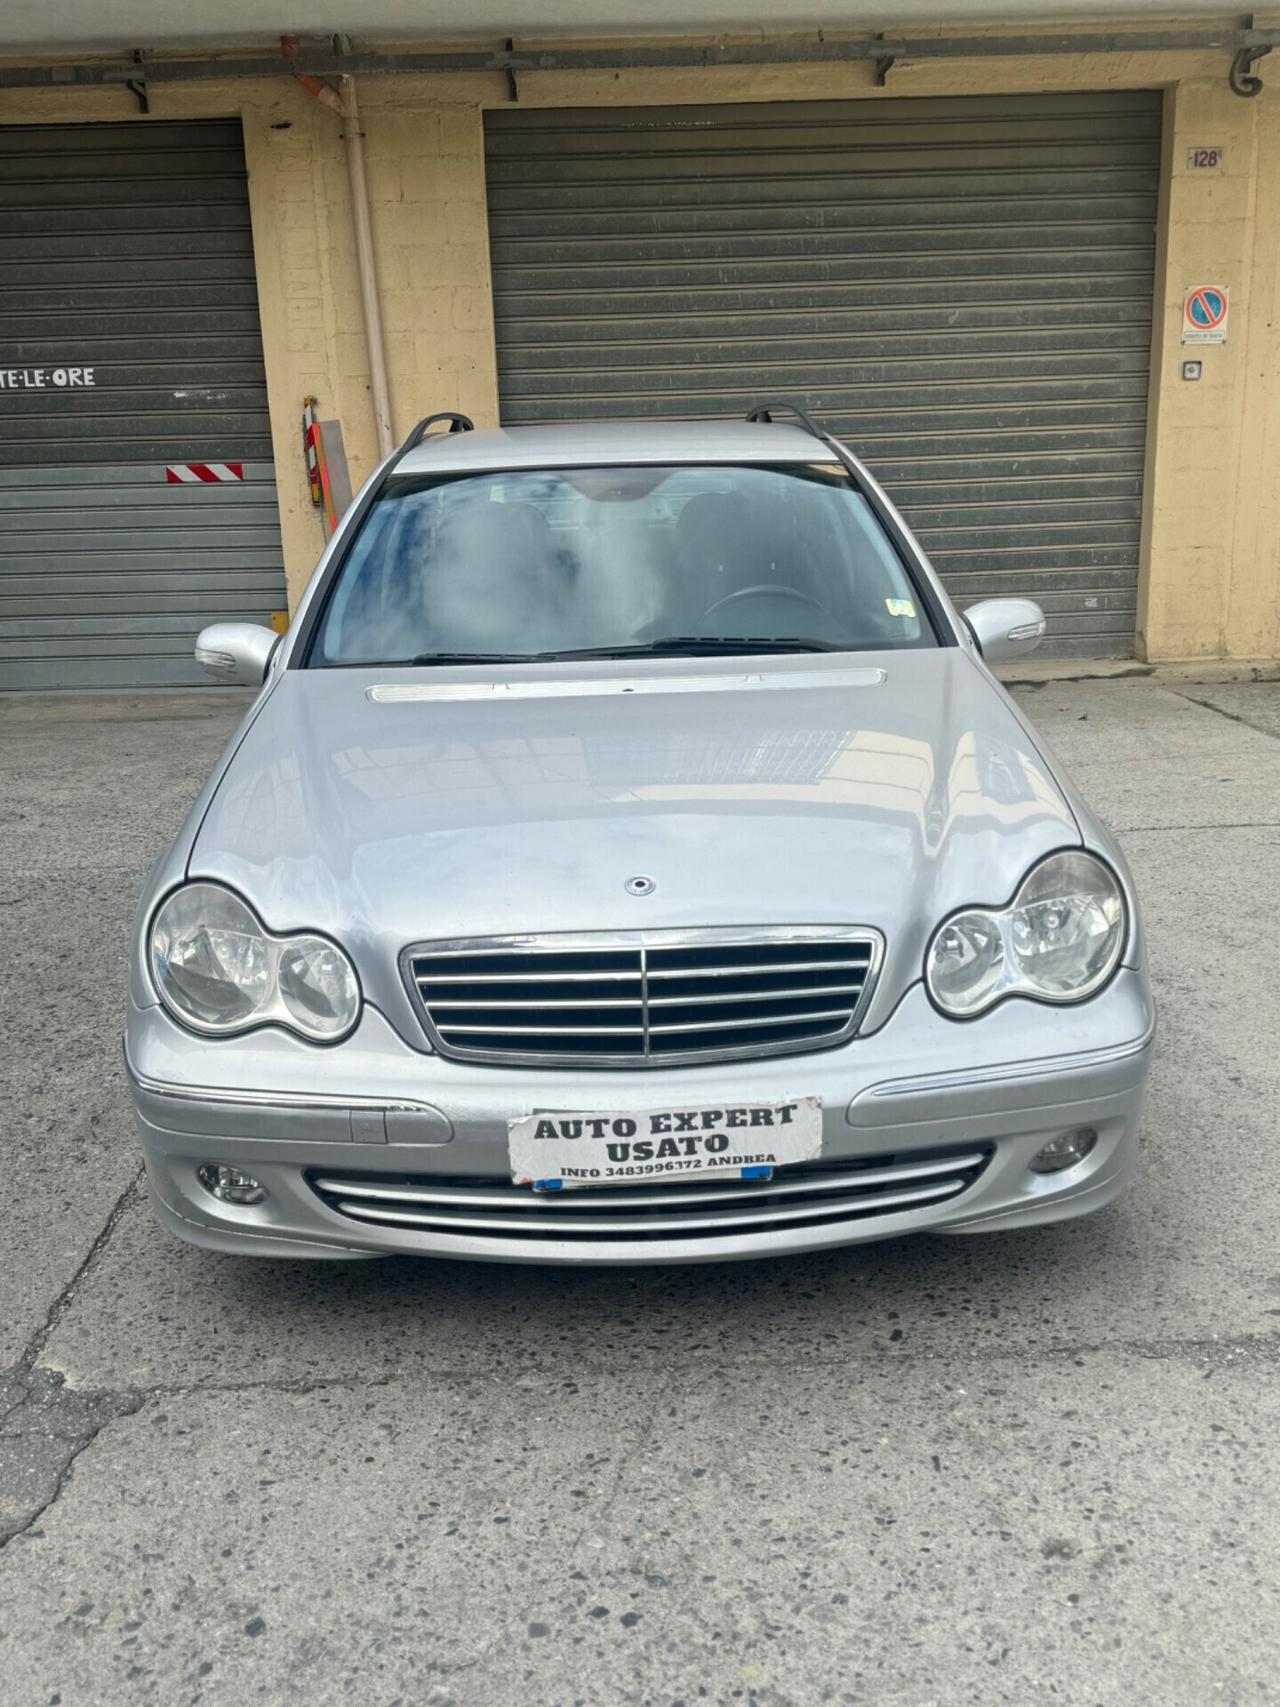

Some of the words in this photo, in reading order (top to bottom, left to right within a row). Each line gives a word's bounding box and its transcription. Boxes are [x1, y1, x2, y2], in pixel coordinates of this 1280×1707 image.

[1194, 150, 1217, 167] 128
[534, 1118, 637, 1139] AUTO
[649, 1104, 798, 1134] EXPERT
[606, 1133, 729, 1162] USATO
[560, 1167, 600, 1177] INFO
[605, 1159, 702, 1176] 3483996372
[707, 1154, 776, 1166] ANDREA
